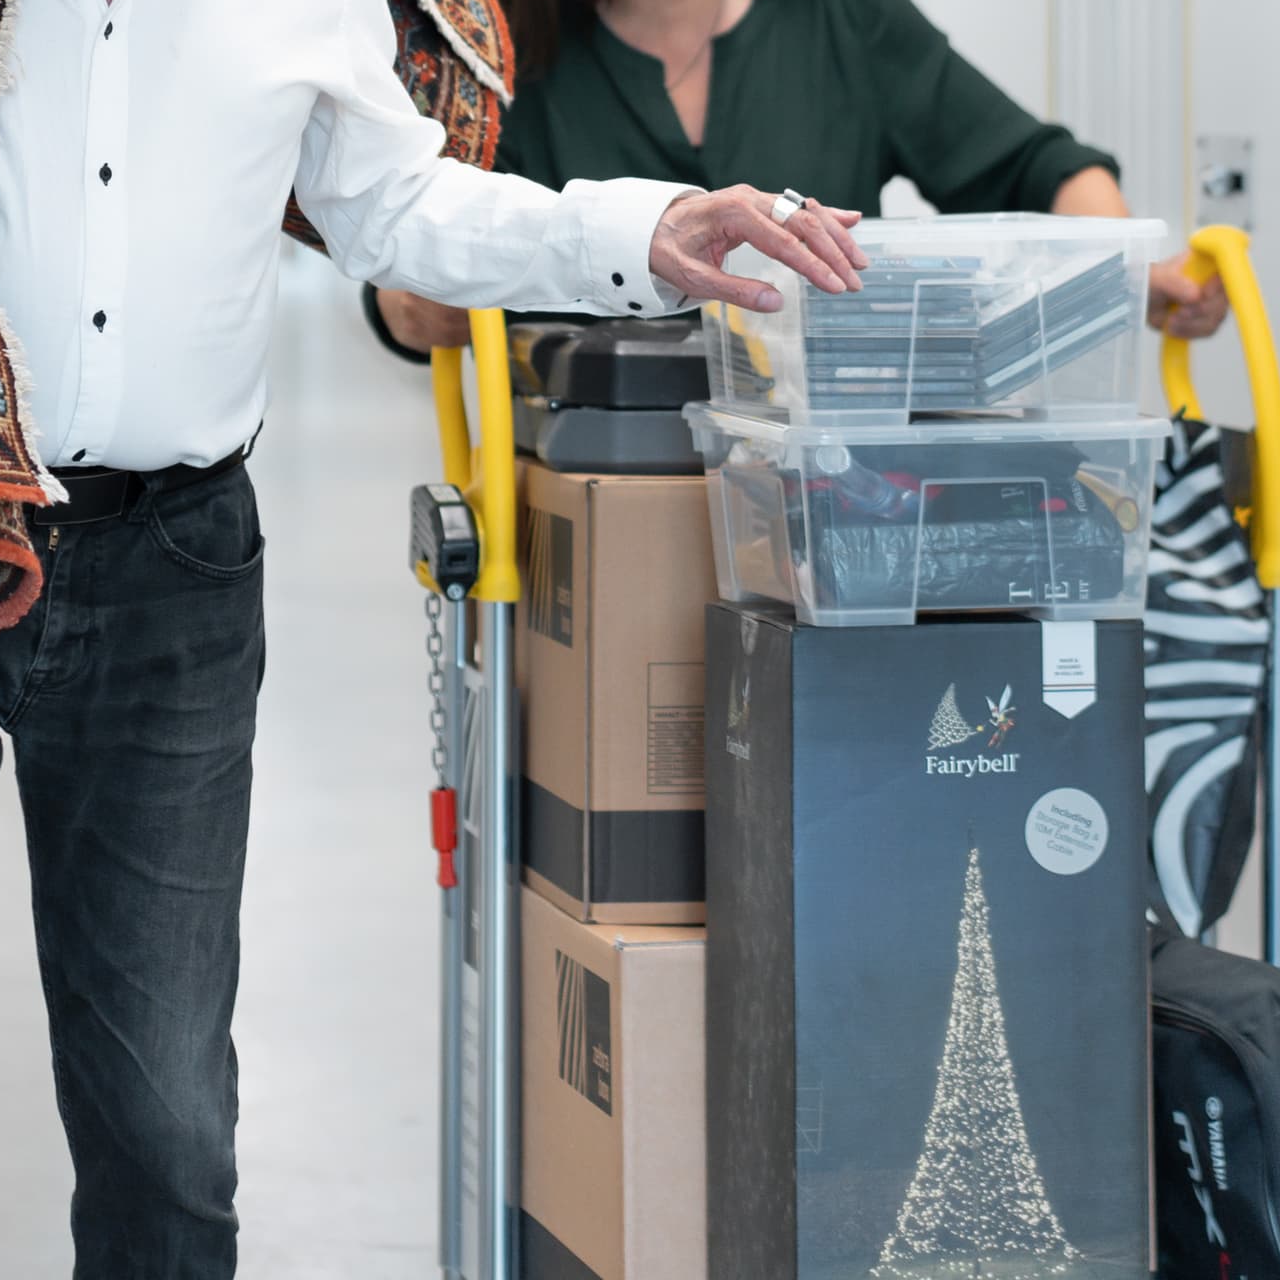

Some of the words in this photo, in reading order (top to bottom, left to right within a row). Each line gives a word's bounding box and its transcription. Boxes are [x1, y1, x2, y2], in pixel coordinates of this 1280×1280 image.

[925, 753, 1017, 778] Fairybell
[1051, 804, 1092, 829] Including
[1208, 1120, 1228, 1190] YAMAHA
